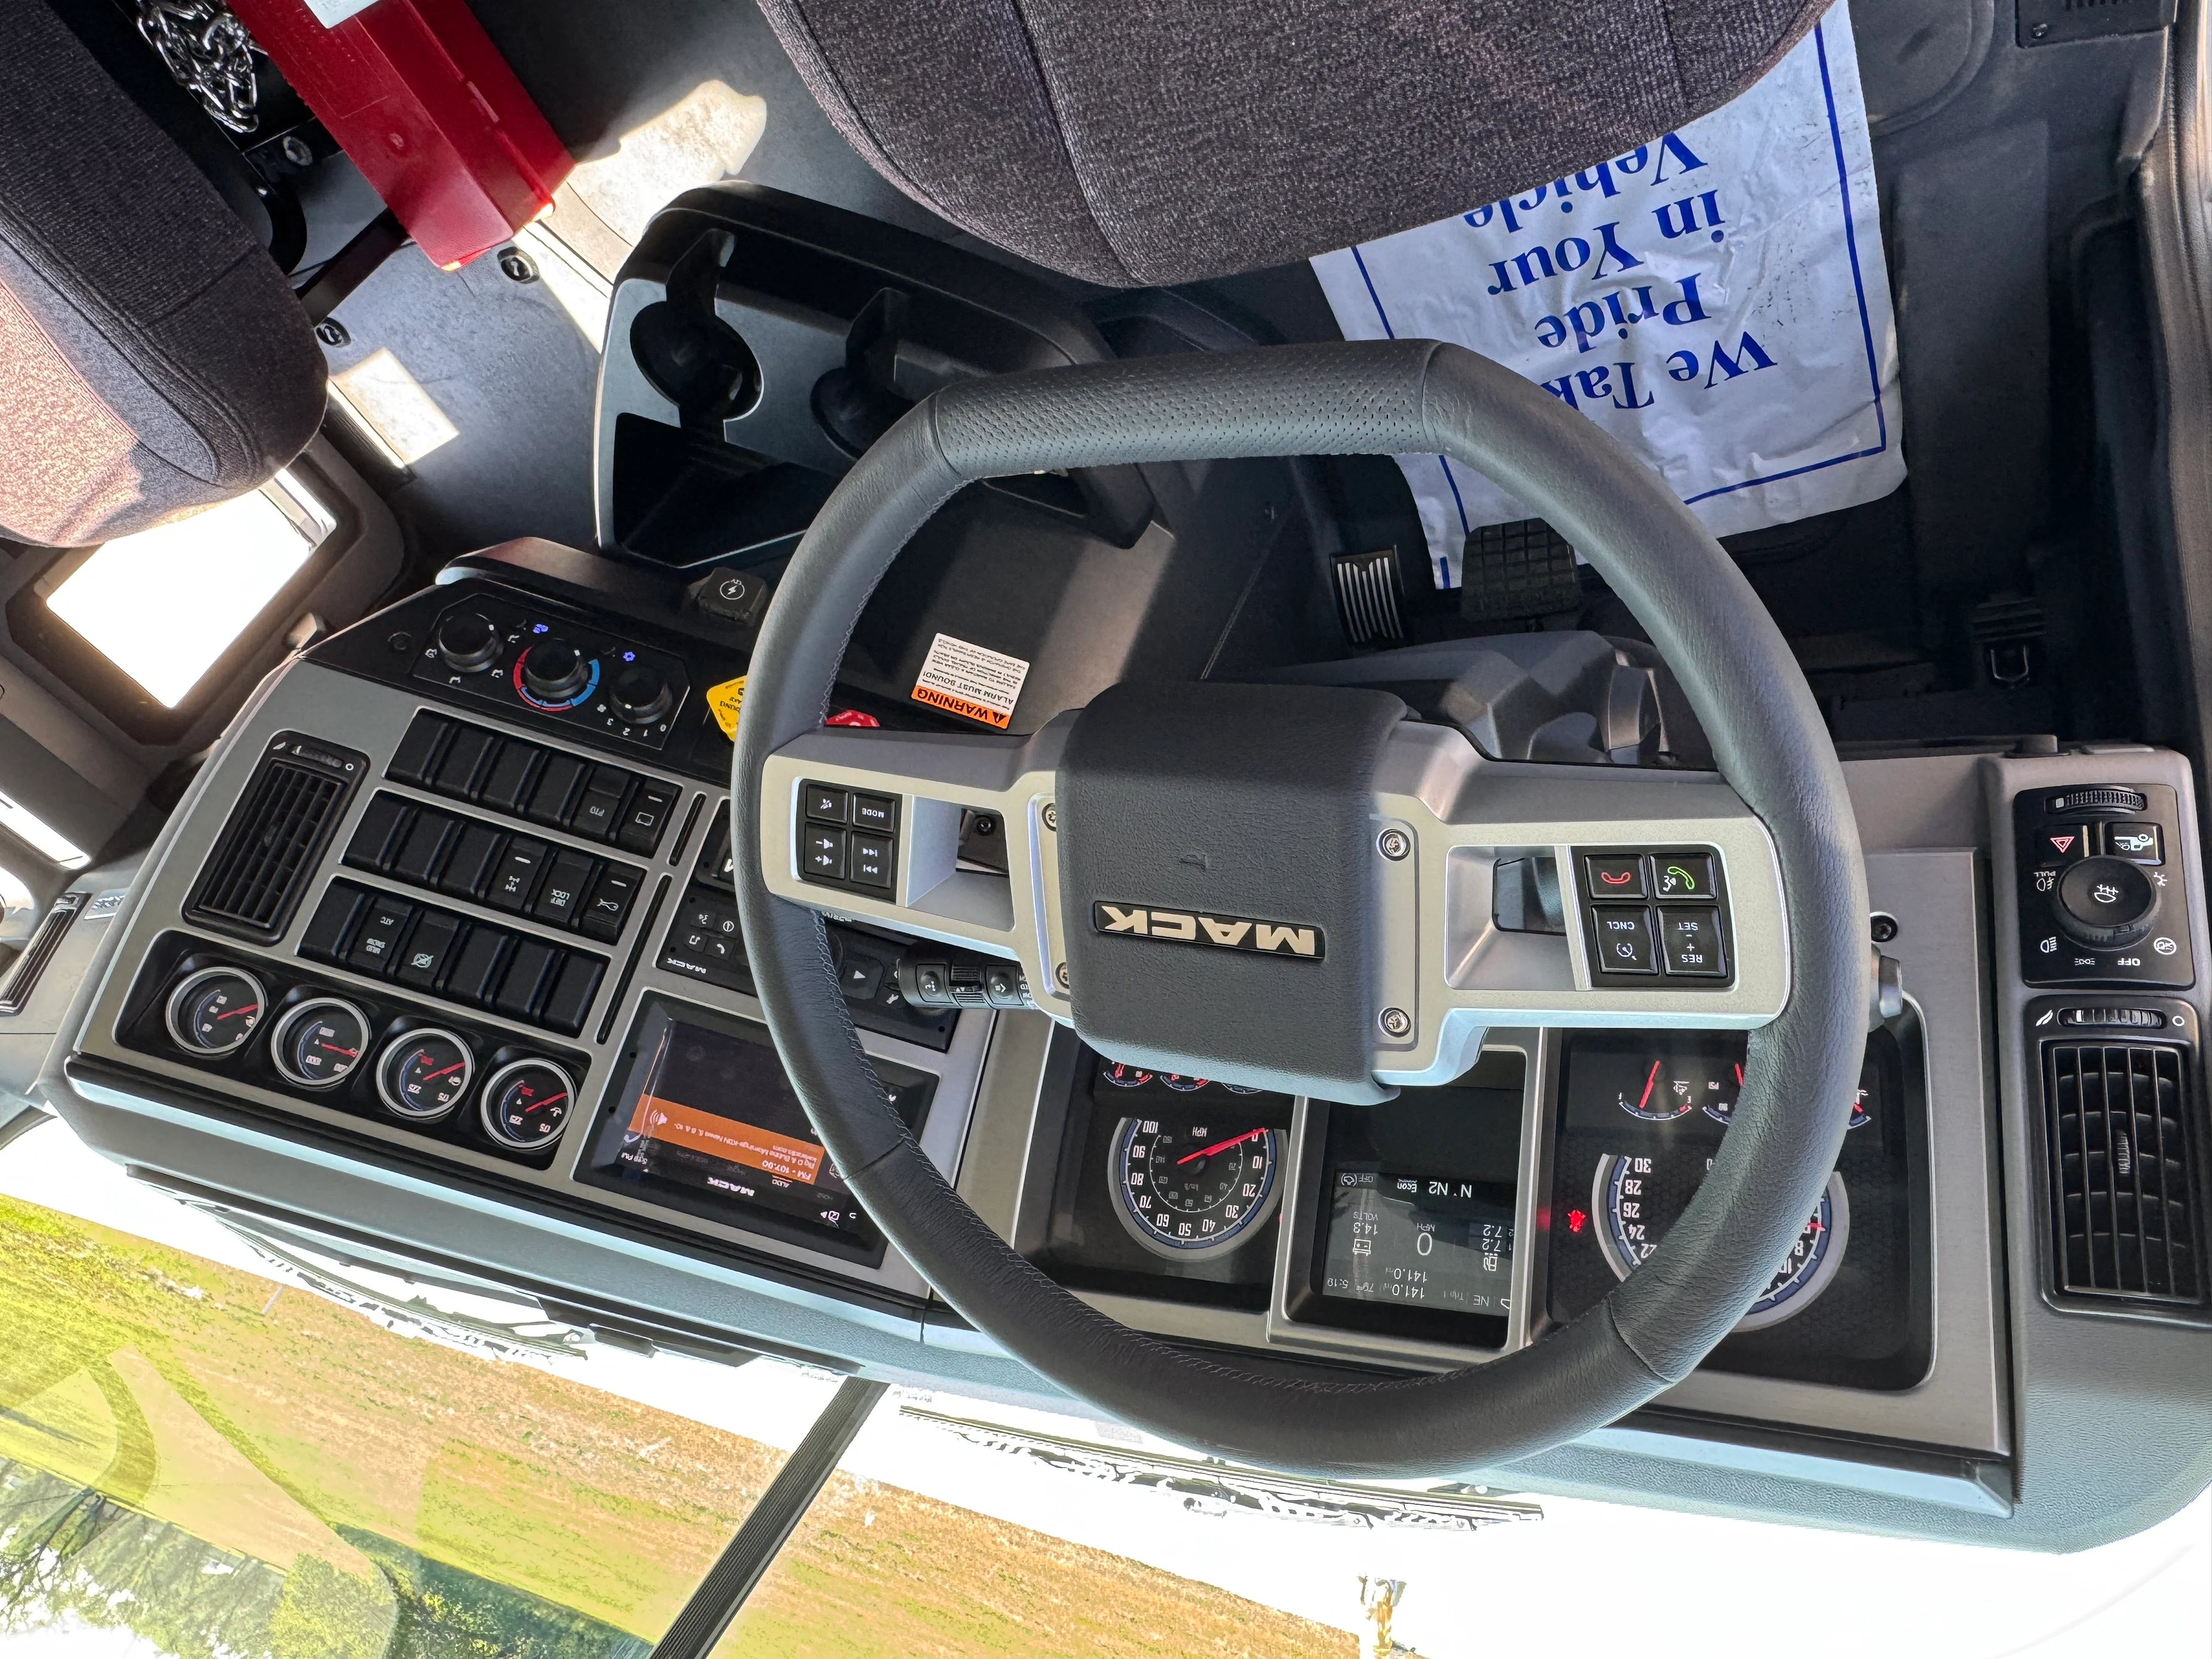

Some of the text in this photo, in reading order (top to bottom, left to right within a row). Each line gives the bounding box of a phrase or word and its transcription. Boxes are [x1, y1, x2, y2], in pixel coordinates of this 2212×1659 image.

[1488, 189, 1725, 295] in Your
[1534, 273, 1711, 353] Pride
[1540, 331, 1778, 410] We Tak
[984, 690, 1014, 704] ALARM
[917, 688, 988, 720] WARNING
[623, 727, 630, 736] 2
[590, 806, 605, 816] PTO
[862, 808, 884, 818] MODE
[1101, 905, 1315, 956] MACK
[1607, 921, 1635, 930] CNCL
[1677, 922, 1698, 930] SET
[1681, 954, 1702, 963] RES
[2118, 958, 2140, 966] OFF
[667, 957, 707, 974] MACK
[1143, 1120, 1158, 1133] 100
[1192, 1126, 1207, 1137] MPH
[1132, 1146, 1146, 1158] 90
[1252, 1155, 1263, 1169] 10
[1634, 1158, 1651, 1173] 30
[1131, 1172, 1144, 1185] 80
[707, 1177, 755, 1197] MACK
[1242, 1183, 1256, 1197] 20
[1397, 1182, 1417, 1193] Econ
[1624, 1179, 1641, 1195] 28
[1139, 1195, 1152, 1208] 70
[1225, 1204, 1239, 1218] 30
[1353, 1211, 1378, 1221] VOLTS
[1623, 1202, 1640, 1218] 26
[1156, 1214, 1169, 1227] 60
[1202, 1219, 1216, 1232] 40
[1178, 1223, 1192, 1236] 50
[1353, 1222, 1378, 1235] 14.3
[1417, 1223, 1435, 1232] MPH
[1483, 1224, 1502, 1238] 7.2
[1628, 1224, 1645, 1239] 24
[1417, 1233, 1432, 1256] 0
[1482, 1238, 1500, 1252] 7.2
[1394, 1268, 1427, 1283] 141.0
[1392, 1284, 1425, 1299] 141.0
[1473, 1295, 1489, 1307] NE
